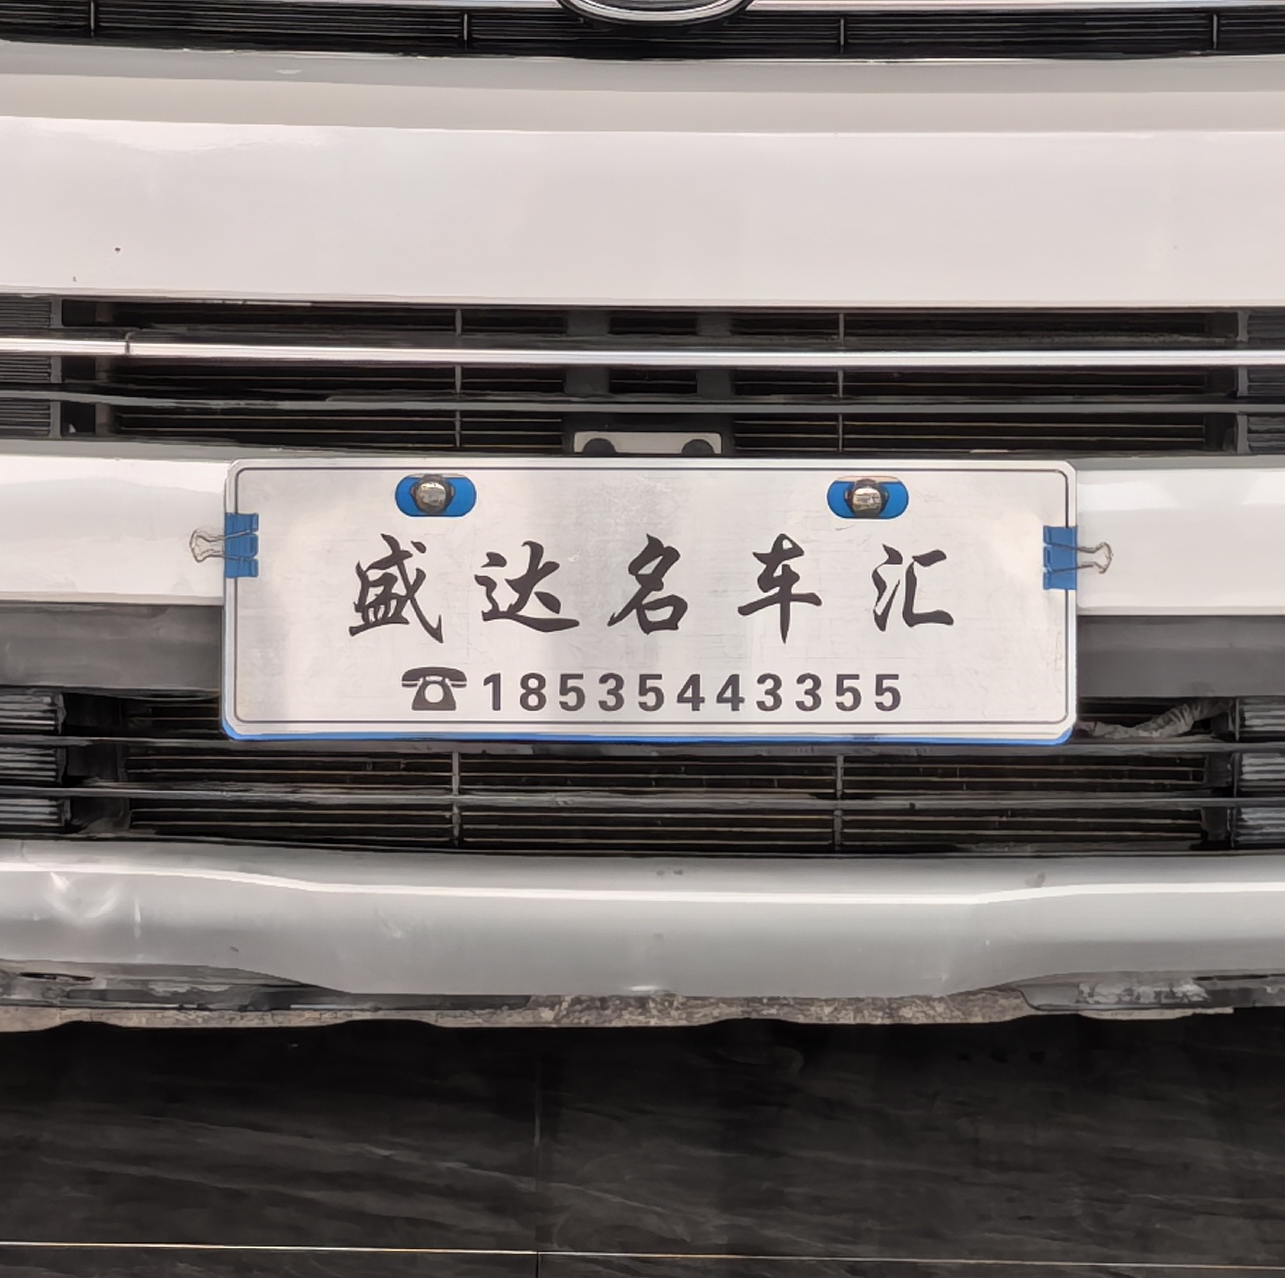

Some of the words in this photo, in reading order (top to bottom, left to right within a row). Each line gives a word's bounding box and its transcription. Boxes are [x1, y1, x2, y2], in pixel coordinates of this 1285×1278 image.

[348, 532, 955, 644] 盛达名车汇
[482, 672, 903, 713] 18535443355
